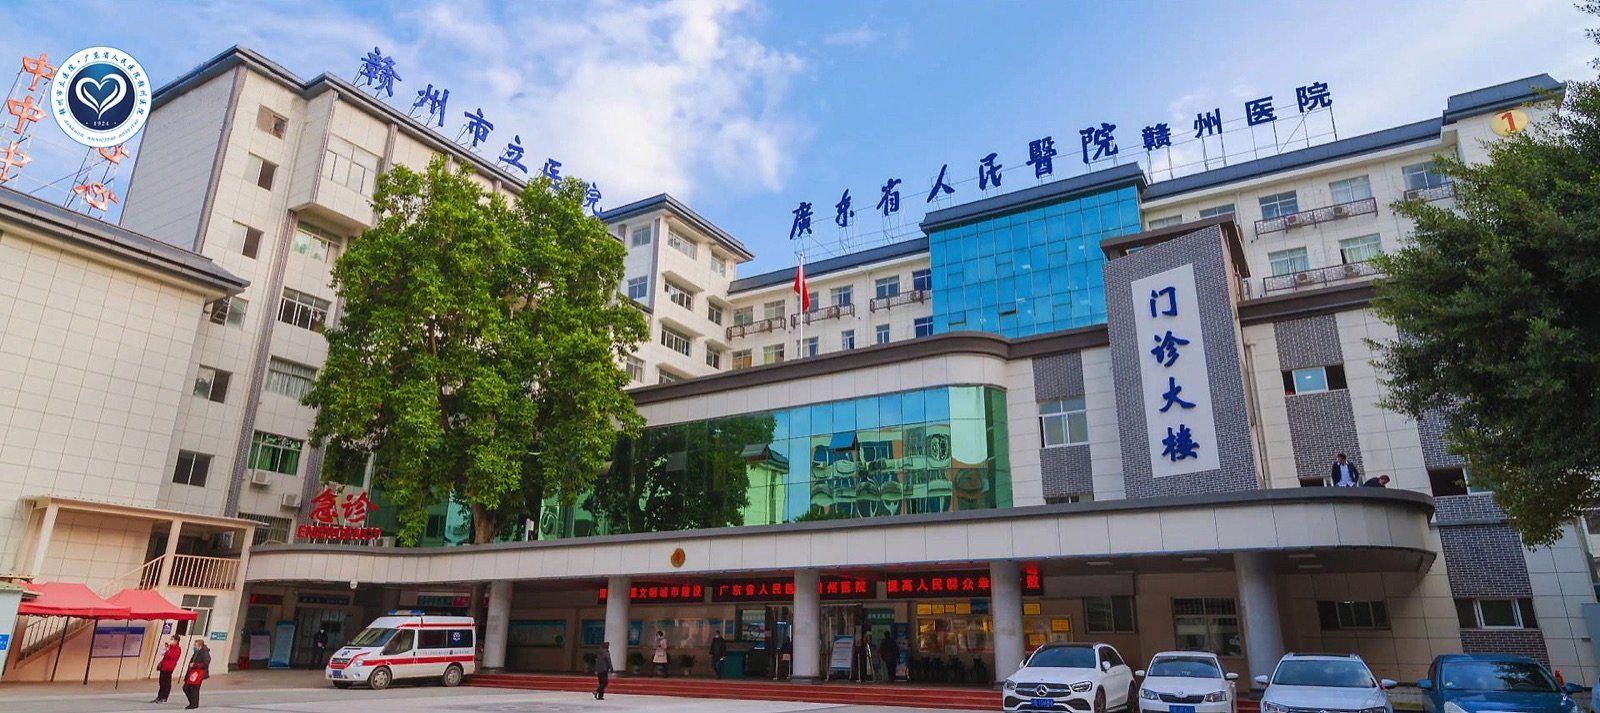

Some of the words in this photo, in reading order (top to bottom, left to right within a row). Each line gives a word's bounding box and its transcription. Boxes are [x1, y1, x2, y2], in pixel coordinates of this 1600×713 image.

[360, 46, 604, 217] 赣州市立医院
[1501, 111, 1517, 132] 1
[1149, 286, 1200, 462] 门诊大楼
[309, 488, 381, 523] 急诊
